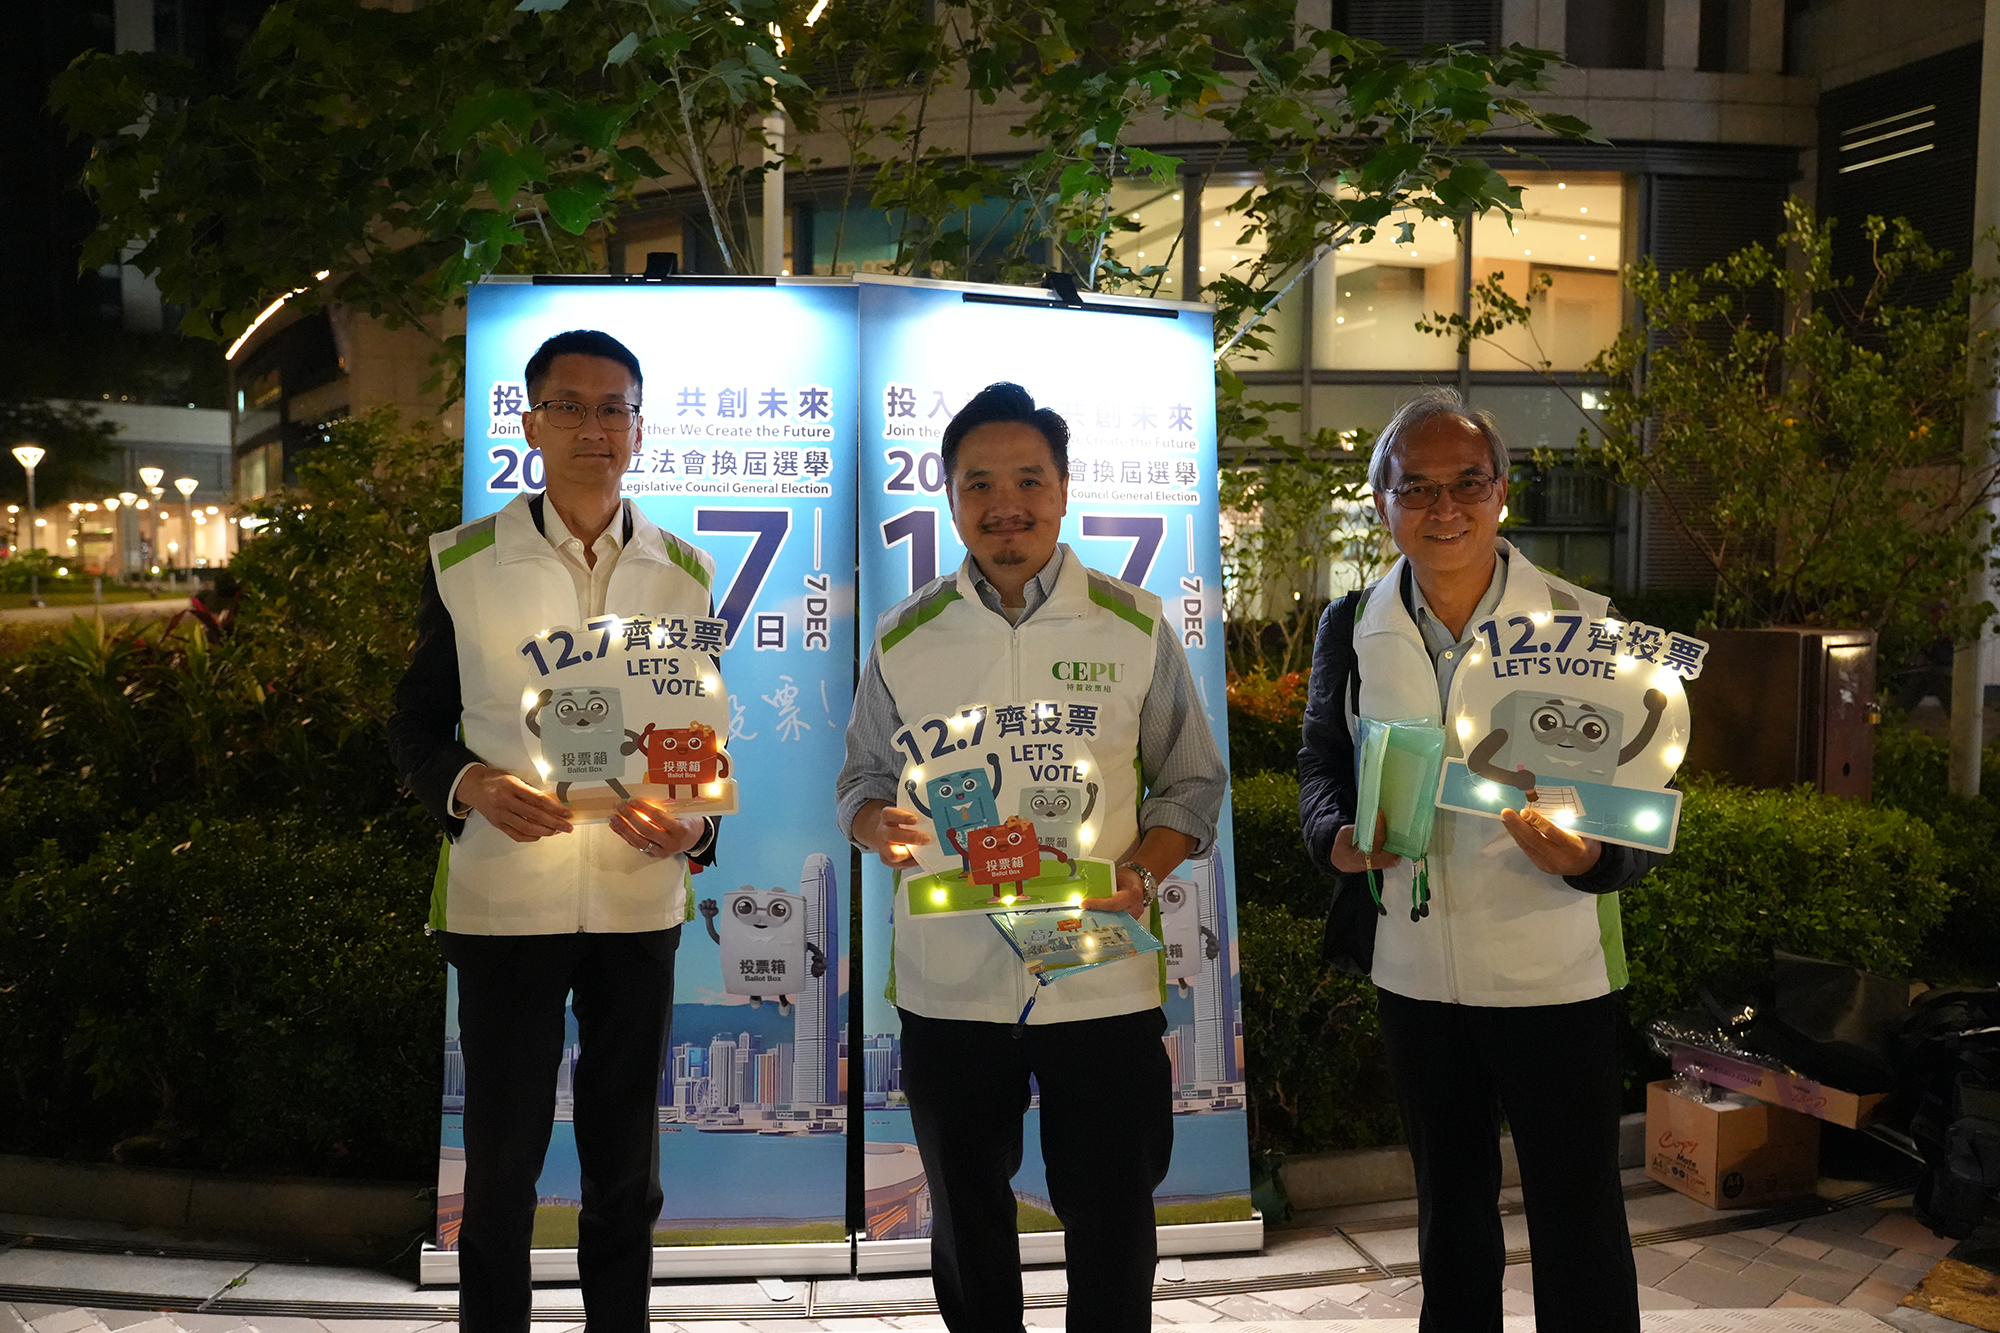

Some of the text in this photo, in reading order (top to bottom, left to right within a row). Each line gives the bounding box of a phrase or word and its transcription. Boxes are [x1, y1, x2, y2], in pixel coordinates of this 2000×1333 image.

[676, 386, 829, 419] 共創未來
[491, 422, 520, 435] Join
[680, 424, 701, 435] We
[706, 424, 752, 437] Create
[757, 425, 780, 437] the
[784, 425, 831, 438] Future
[886, 423, 941, 438] Join the
[1086, 434, 1127, 447] Create
[1131, 436, 1152, 448] the
[1155, 437, 1196, 450] Future
[620, 481, 829, 494] Legislative Council General Election
[1071, 488, 1198, 503] Council General Election
[805, 577, 828, 649] 7 DEC
[1183, 579, 1204, 646] 7 DEC
[626, 658, 680, 677] LET'S
[1051, 660, 1126, 684] CEPU
[1492, 656, 1617, 681] LET'S VOTE
[651, 678, 707, 698] VOTE
[561, 751, 608, 767] 投票箱
[1010, 743, 1064, 763] LET'S
[566, 766, 603, 774] Ballot Box
[663, 760, 701, 773] 投票箱
[1028, 765, 1084, 784] VOTE
[985, 856, 1024, 872] 投票箱
[991, 870, 1009, 878] Ballot
[740, 959, 786, 975] 投票箱
[1658, 1131, 1699, 1154] Copy
[1677, 1153, 1697, 1168] Mate
